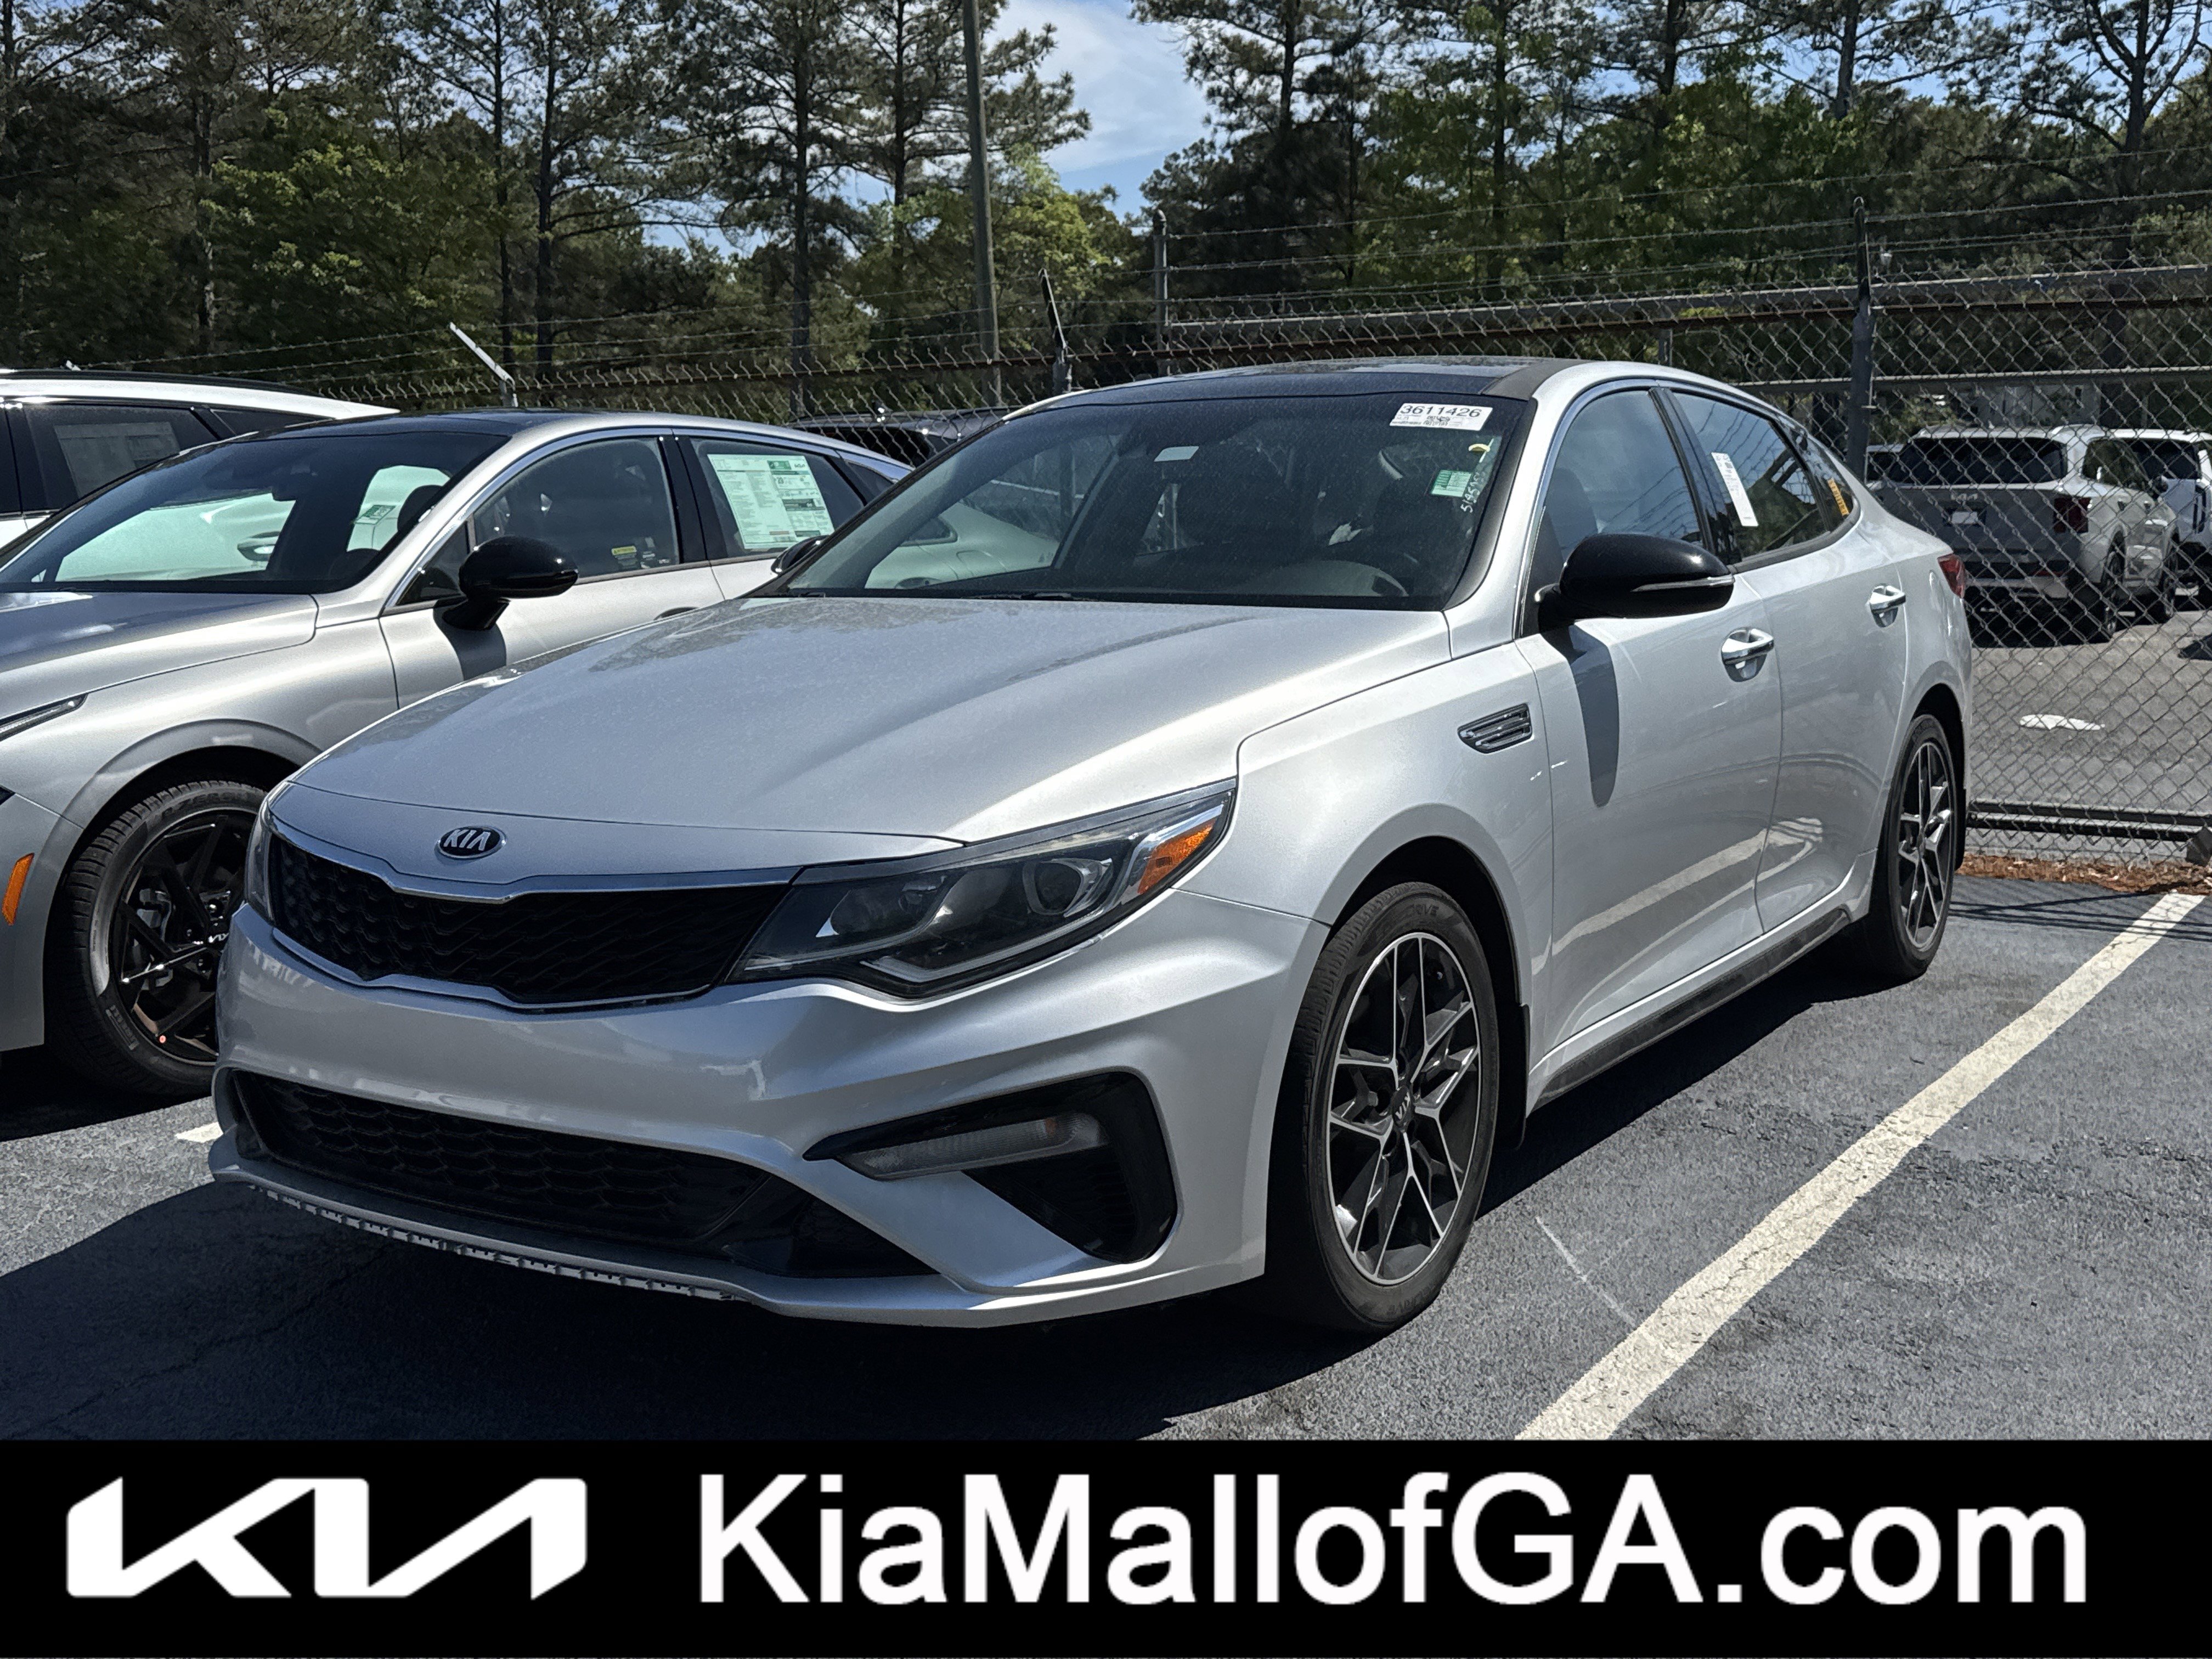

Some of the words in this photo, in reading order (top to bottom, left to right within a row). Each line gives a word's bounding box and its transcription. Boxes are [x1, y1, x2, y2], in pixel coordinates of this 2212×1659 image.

[1400, 405, 1482, 417] 3611426
[443, 829, 491, 851] KIA
[1395, 1091, 1411, 1120] KIA
